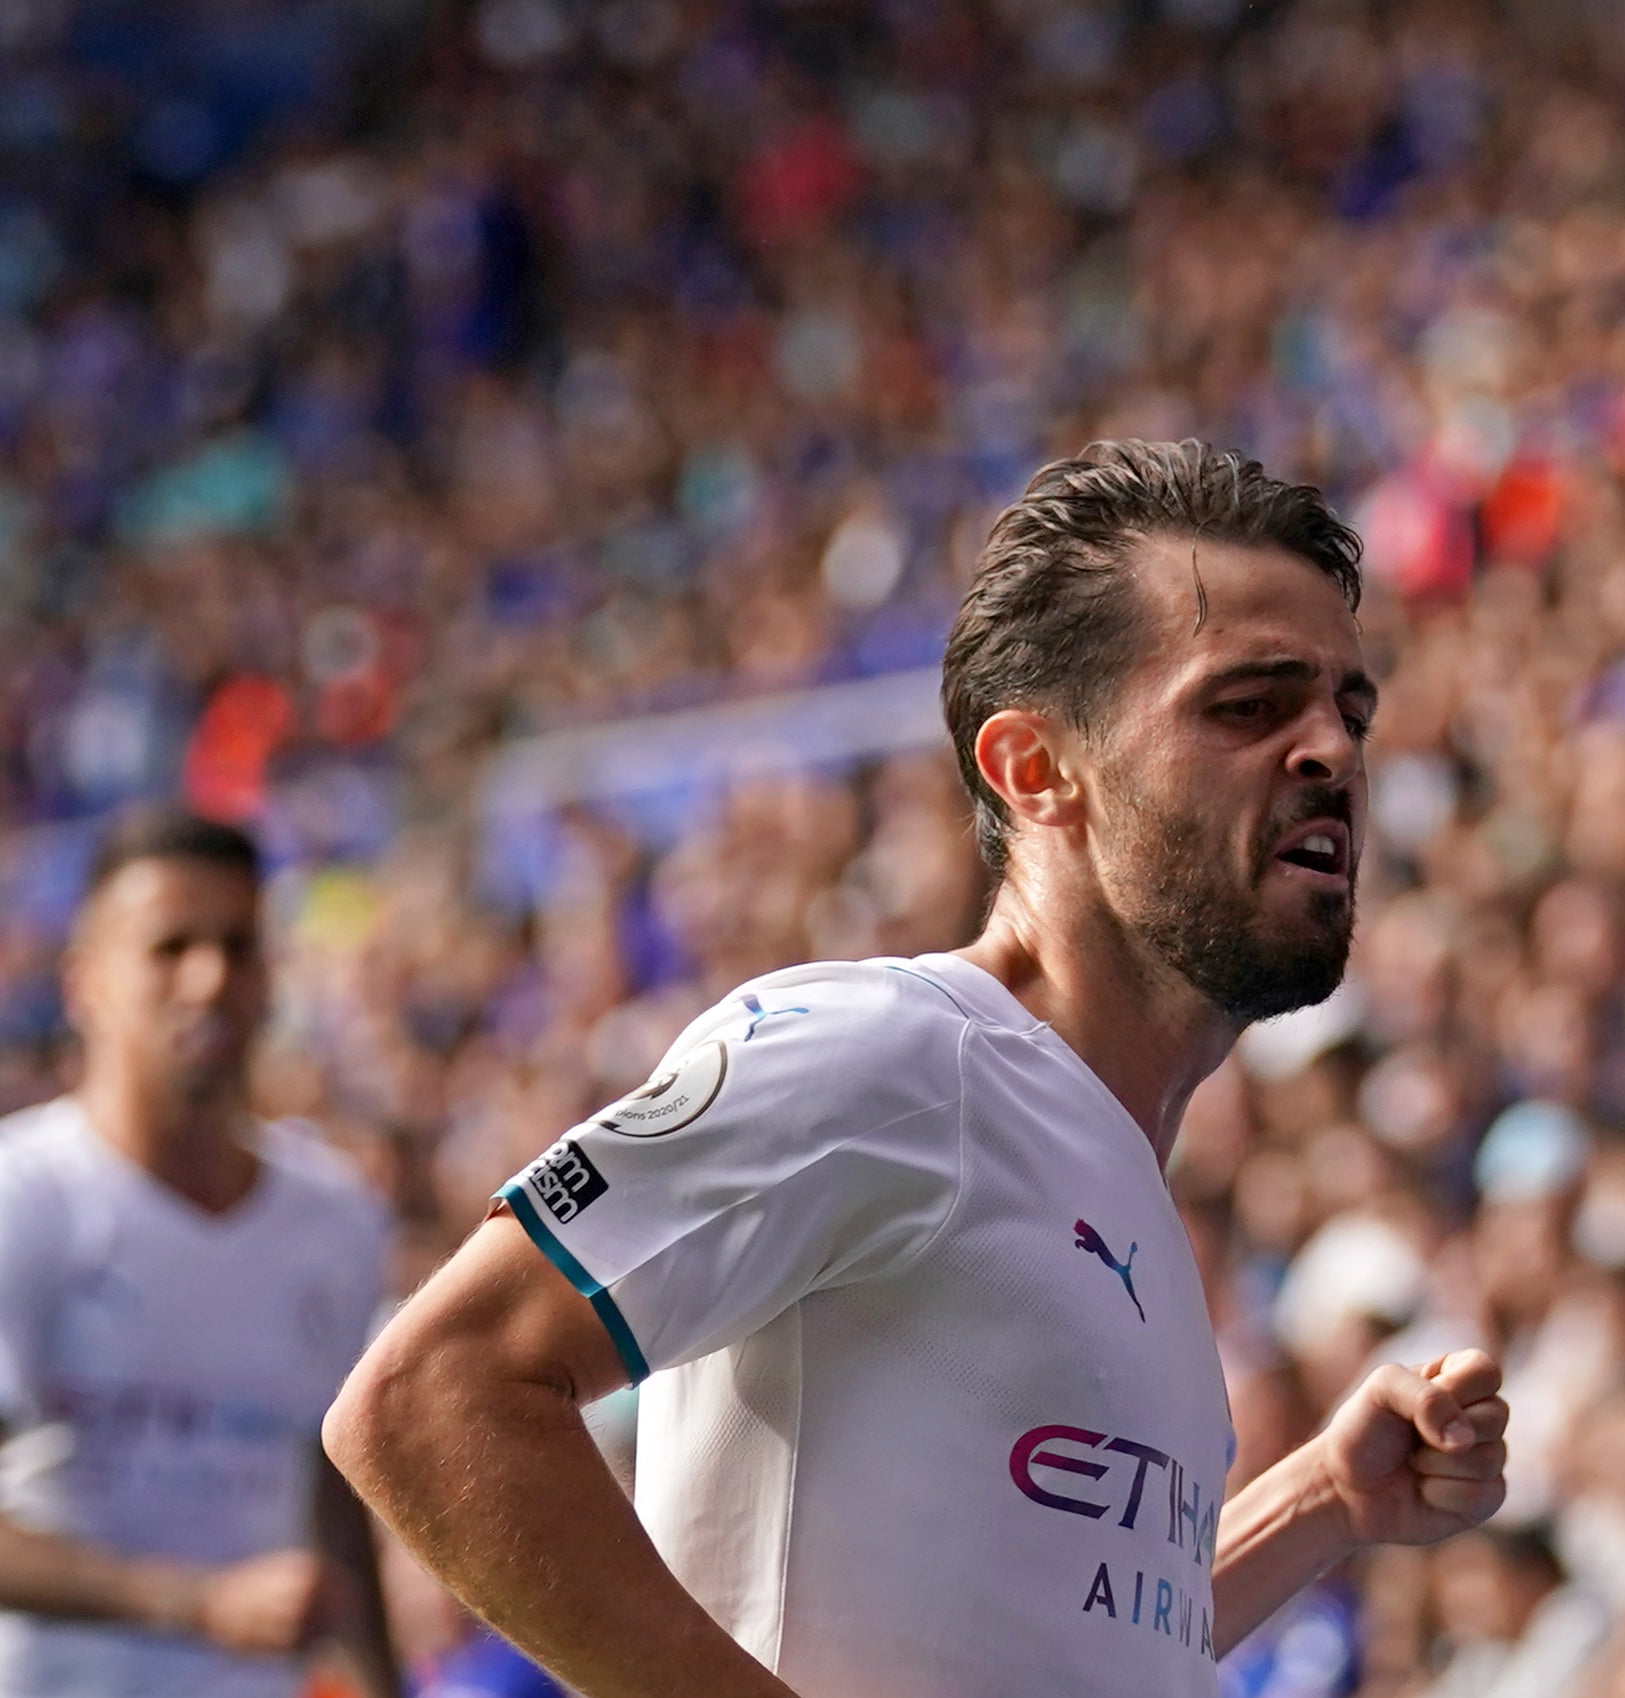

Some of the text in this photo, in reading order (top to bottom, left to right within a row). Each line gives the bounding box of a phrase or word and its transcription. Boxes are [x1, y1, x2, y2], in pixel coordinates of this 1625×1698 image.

[648, 1095, 690, 1120] 2020/21
[531, 1161, 579, 1222] ism
[546, 1141, 590, 1193] om
[1009, 1425, 1216, 1569] ETIHA
[1082, 1562, 1217, 1661] AIRWA
